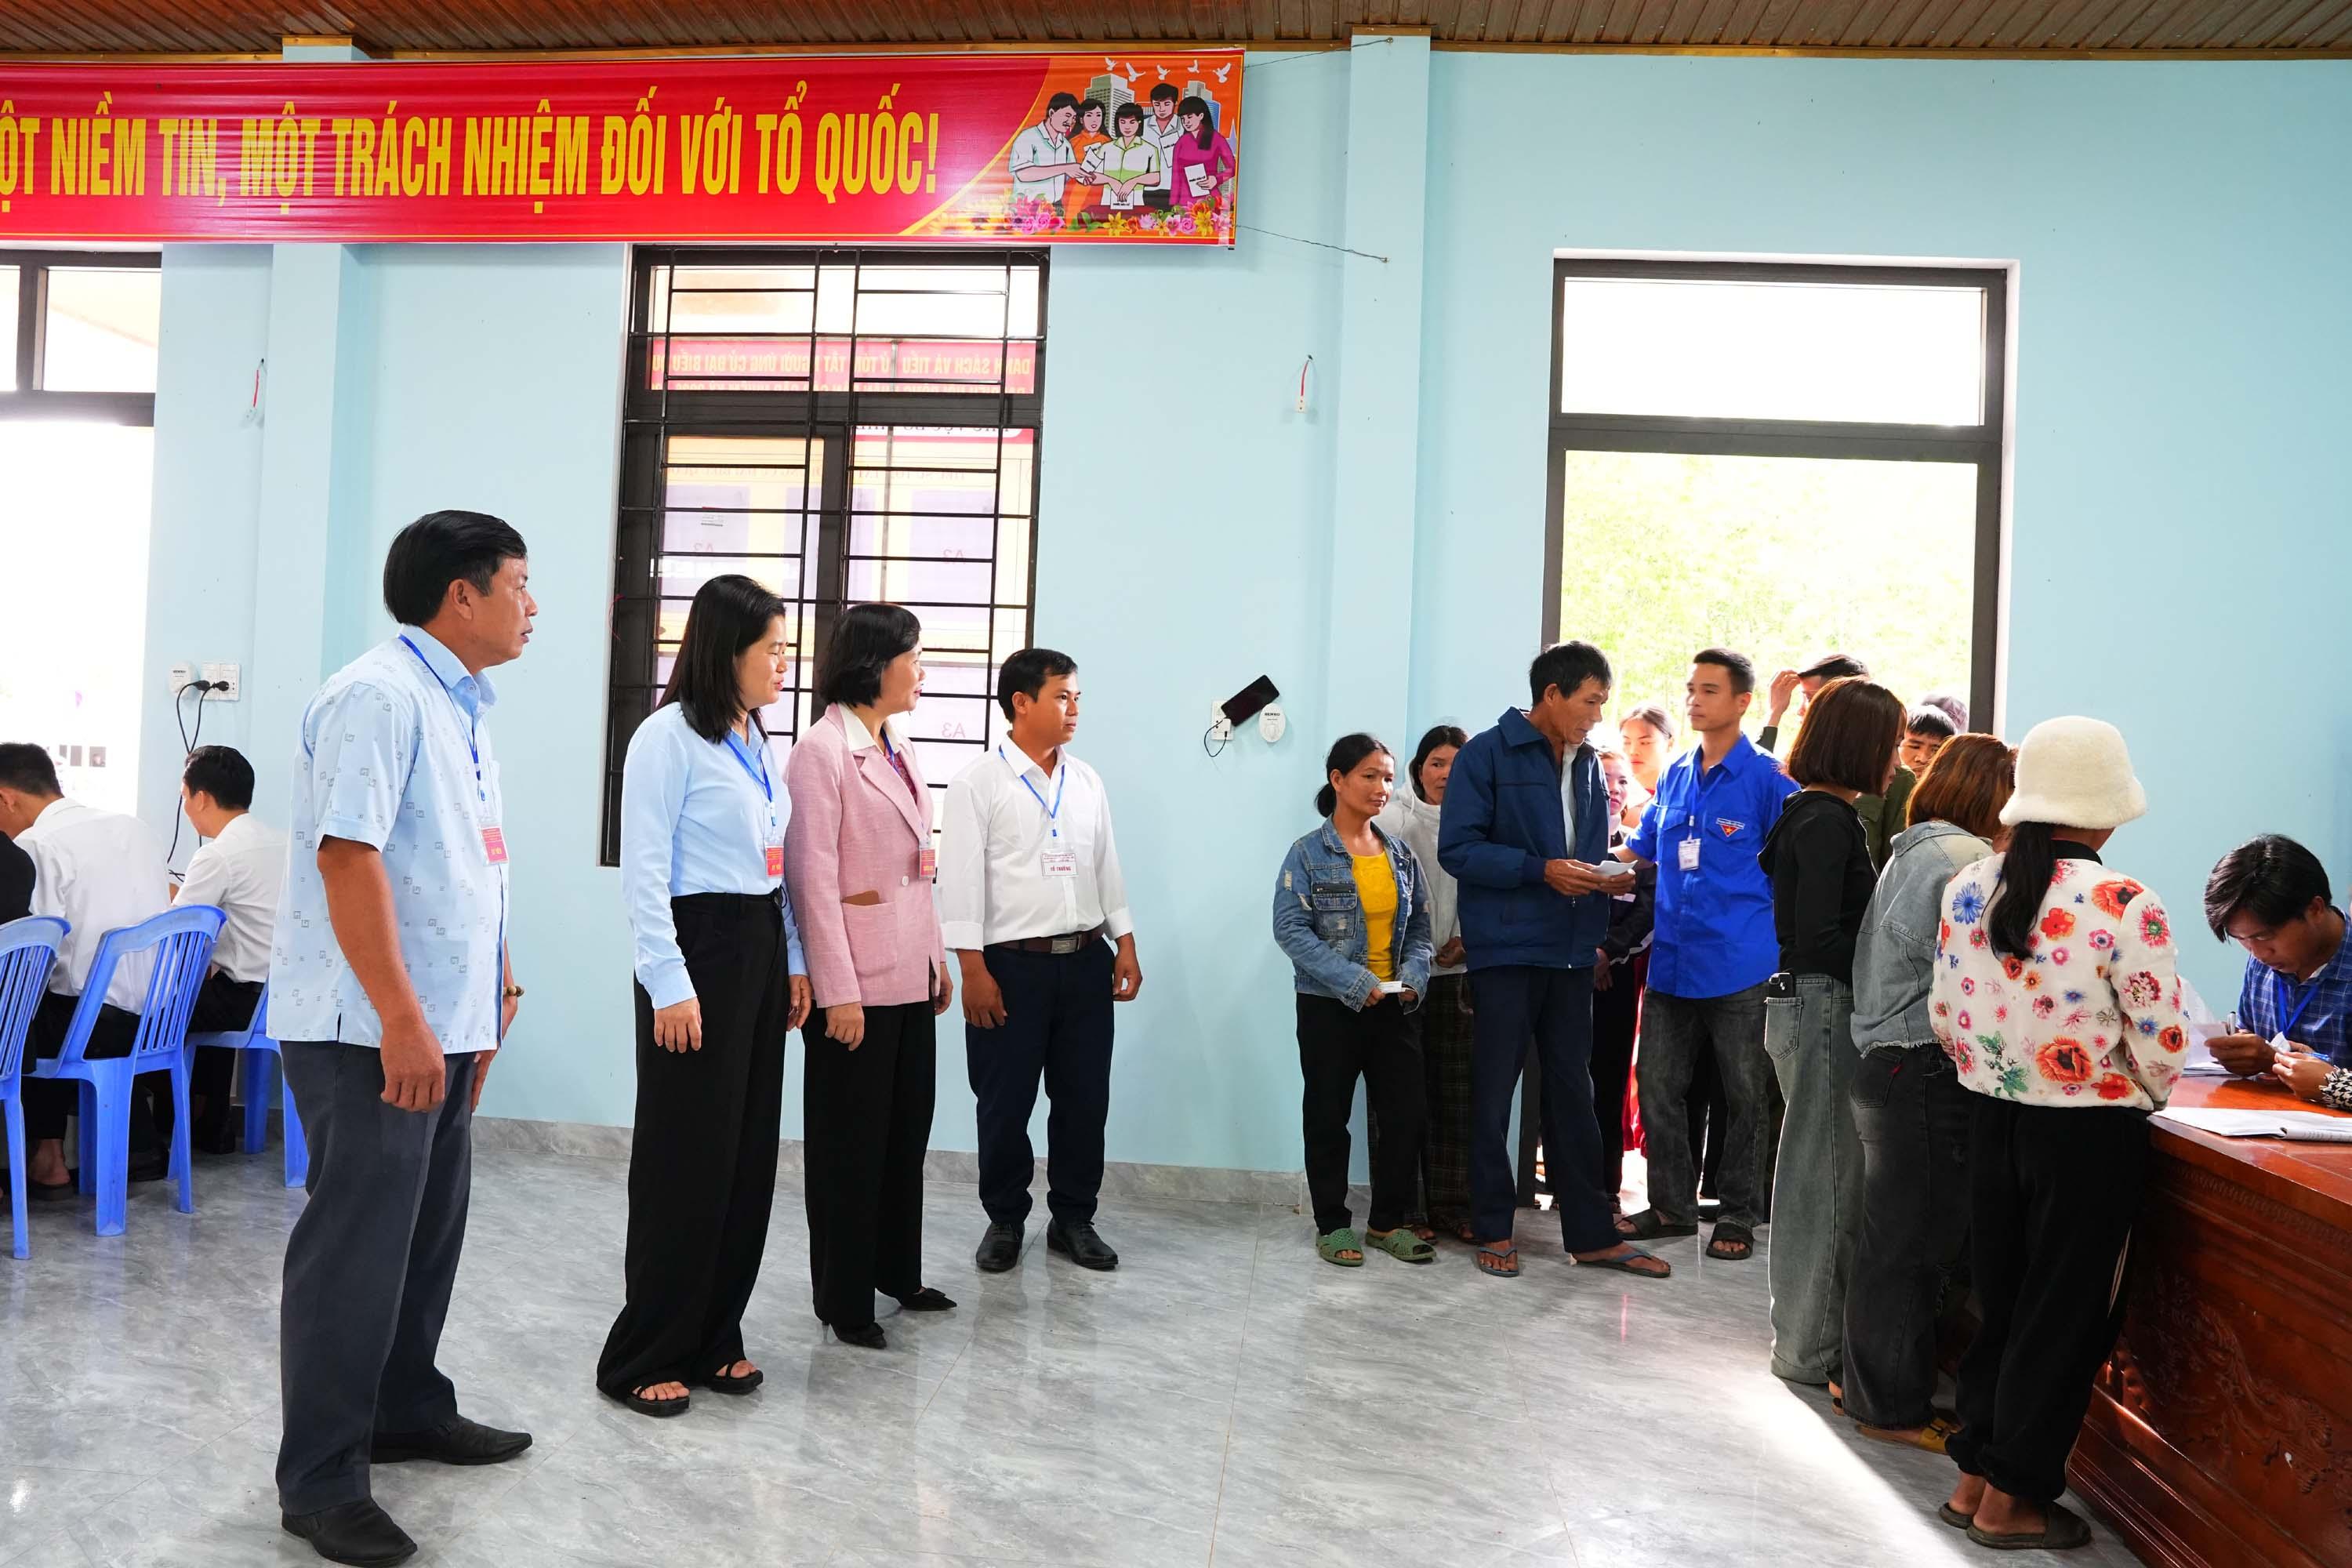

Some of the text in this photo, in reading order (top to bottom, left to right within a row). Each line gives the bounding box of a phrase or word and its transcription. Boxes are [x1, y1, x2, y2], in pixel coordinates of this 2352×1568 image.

[51, 91, 145, 196] NIỀM
[158, 118, 227, 207] TIN,
[241, 101, 321, 214] MỘT
[331, 100, 452, 198] TRÁCH
[463, 98, 589, 213] NHIỆM
[601, 86, 666, 195] ĐỐI
[680, 96, 742, 195] VỚI
[756, 80, 807, 194] TỔ
[815, 82, 939, 204] QUỐC!
